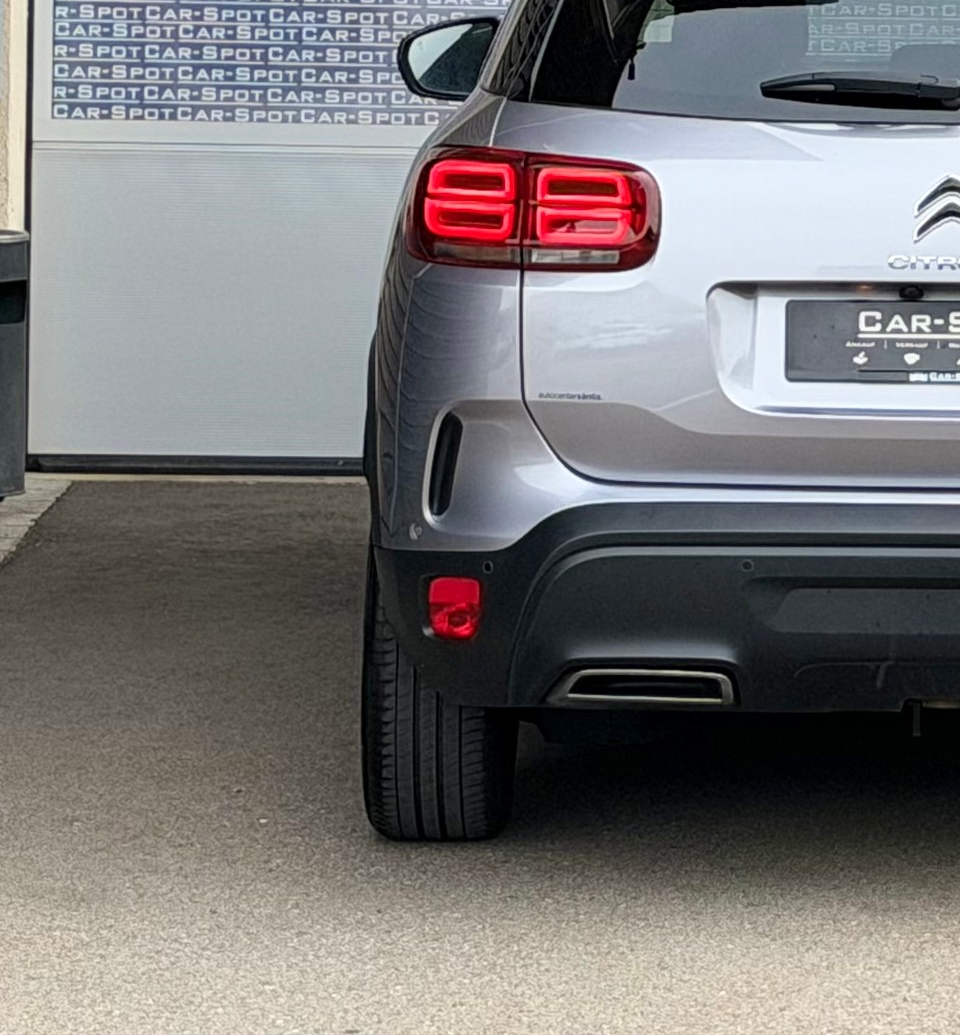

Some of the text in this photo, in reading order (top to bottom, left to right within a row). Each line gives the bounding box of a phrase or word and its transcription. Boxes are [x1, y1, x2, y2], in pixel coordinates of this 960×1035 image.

[145, 6, 389, 23] CAR-SPOT CAR-SPOT
[55, 23, 299, 40] CAR-SPOT CAR-SPOT
[144, 45, 388, 62] CAR-SPOT CAR-SPOT
[54, 64, 174, 79] CAR-SPOT
[177, 66, 298, 81] CAR-SPOT
[144, 86, 387, 103] CAR-SPOT CAR-SPOT
[53, 105, 420, 124] CAR-SPOT CAR-SPOT CAR-SPOT
